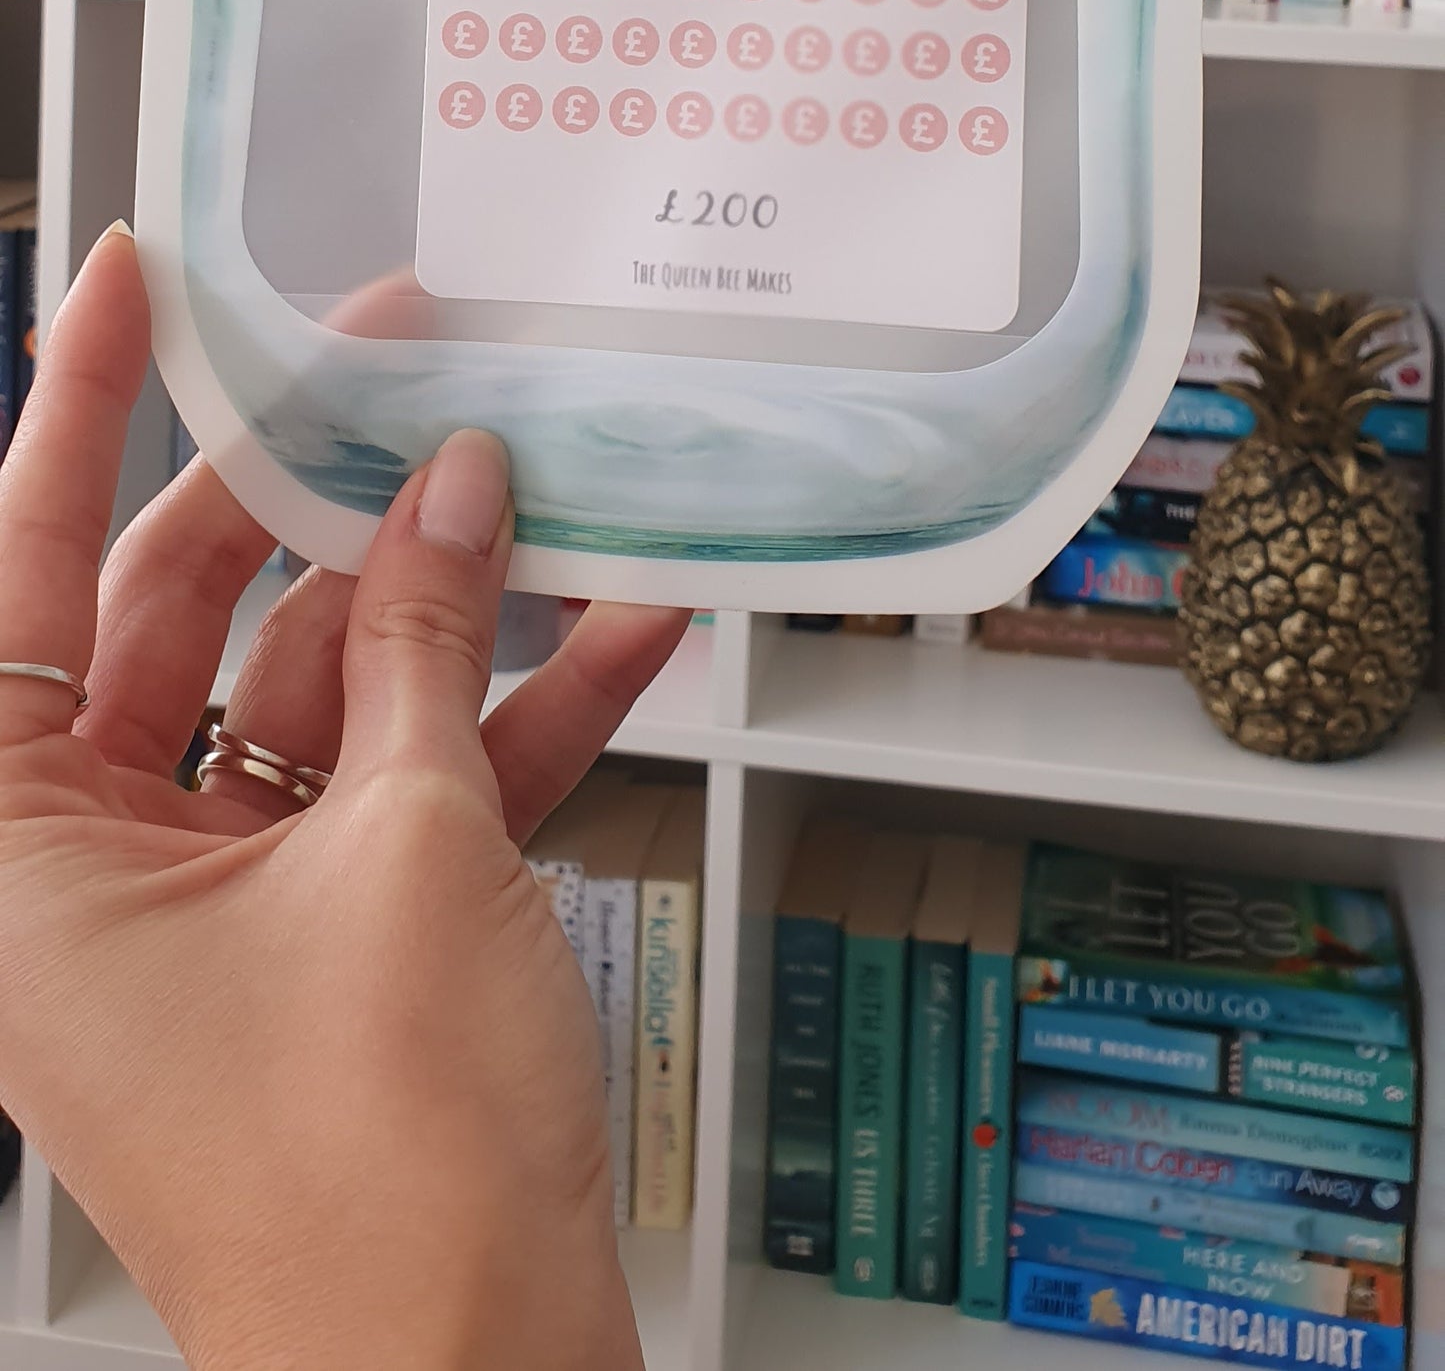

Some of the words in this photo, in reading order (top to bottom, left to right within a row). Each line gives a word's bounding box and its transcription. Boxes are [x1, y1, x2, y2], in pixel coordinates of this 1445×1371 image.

[1084, 976, 1141, 1006] LET
[1148, 982, 1217, 1016] YOU
[1220, 994, 1272, 1023] GO
[1296, 1168, 1368, 1208] Away
[1135, 1291, 1290, 1359] AMERICAN
[1294, 1319, 1369, 1370] DIRT
